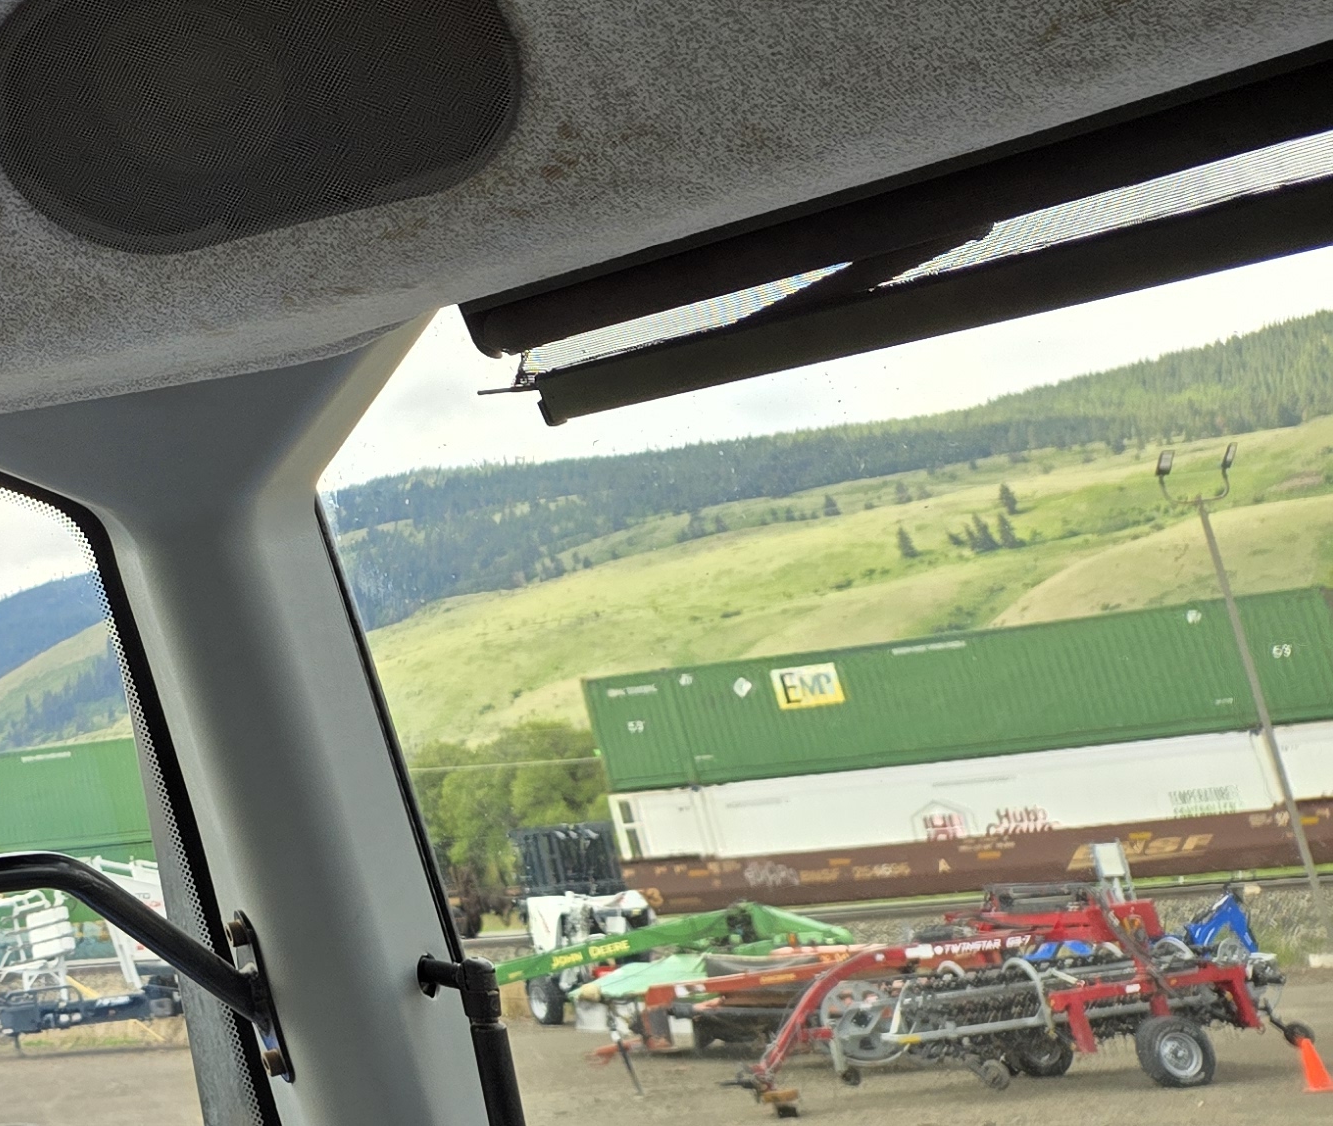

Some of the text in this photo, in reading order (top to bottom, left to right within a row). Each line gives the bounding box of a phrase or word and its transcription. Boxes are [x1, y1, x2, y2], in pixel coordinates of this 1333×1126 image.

[780, 672, 832, 704] EMP
[551, 939, 631, 970] JOHN DEERE
[944, 938, 1001, 955] TWINSTAR
